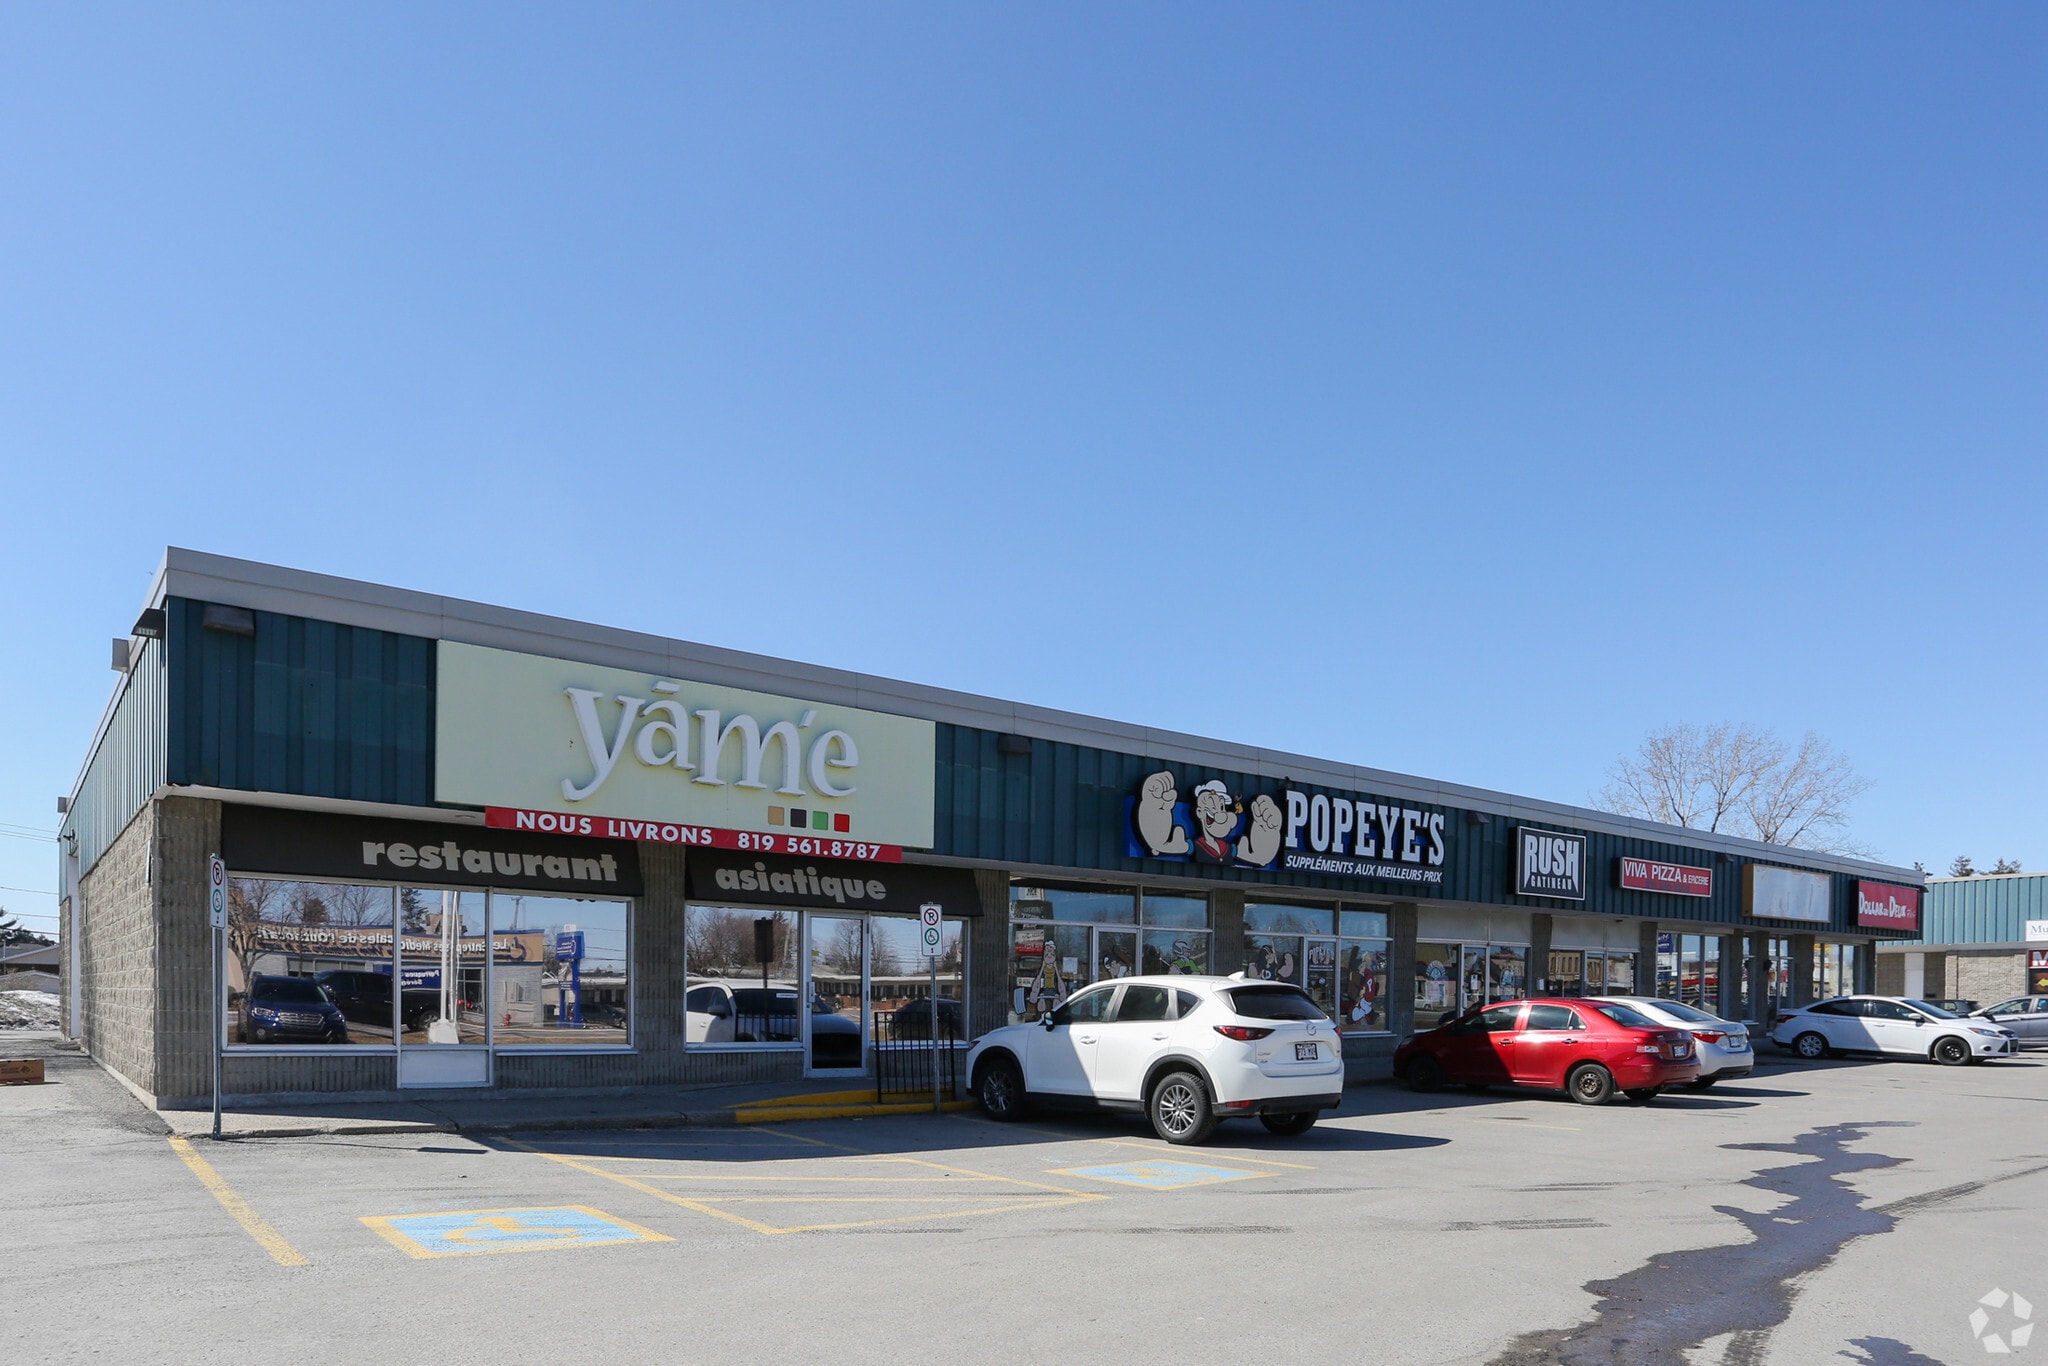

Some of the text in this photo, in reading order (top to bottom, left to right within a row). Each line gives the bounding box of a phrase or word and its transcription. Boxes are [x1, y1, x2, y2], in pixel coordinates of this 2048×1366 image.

[515, 811, 881, 860] NOUS LIVRONS 819 561.8787
[1285, 790, 1444, 866] POPEYE'S
[362, 841, 618, 882] restaurant
[1286, 855, 1442, 883] SUPPLÉMENTS AUX MEILLEURS PRIX
[1524, 834, 1580, 893] RUSH
[1530, 874, 1572, 890] GATINEAU
[1624, 860, 1648, 879] VIVA
[1651, 864, 1682, 883] PIZZA
[715, 862, 887, 903] asiatique
